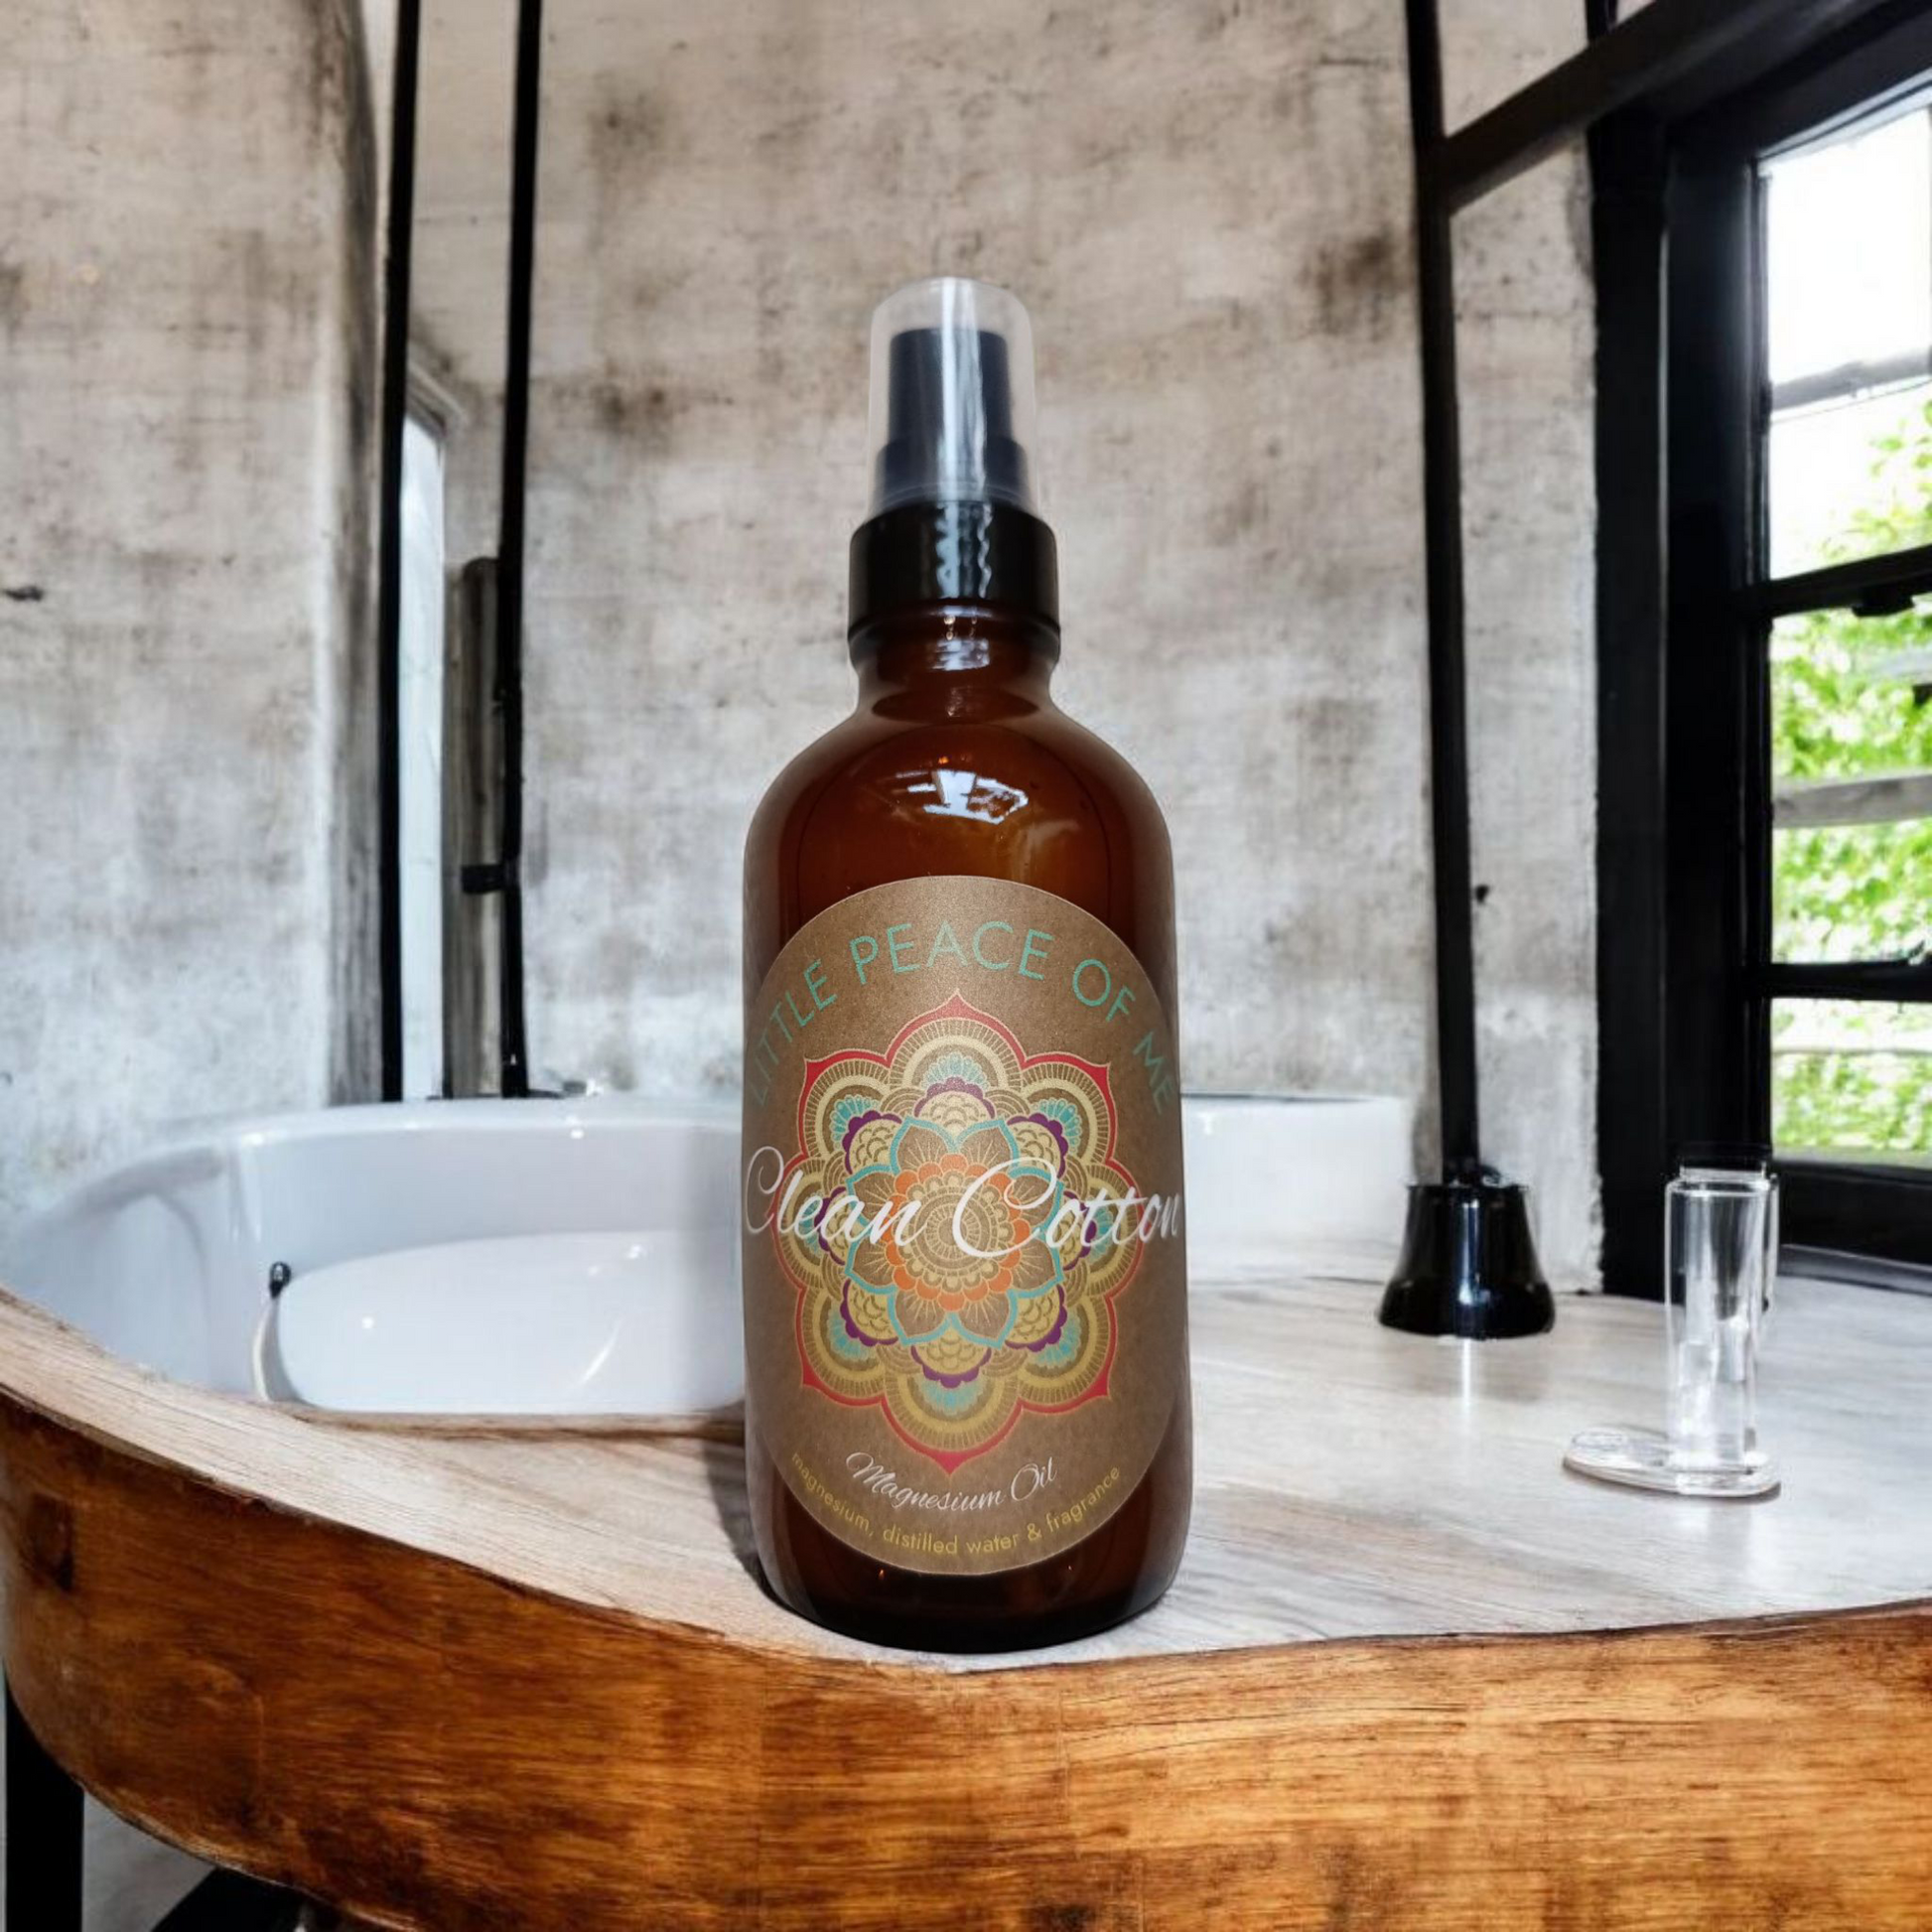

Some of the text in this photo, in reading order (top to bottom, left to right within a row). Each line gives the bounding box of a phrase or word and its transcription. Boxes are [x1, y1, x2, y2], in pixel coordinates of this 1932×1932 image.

[751, 920, 1175, 1116] LITTLE PEACE OF ME
[745, 1146, 1181, 1258] Clean Cotton
[791, 1452, 1121, 1555] magnesium, distilled water & fragrance
[846, 1451, 1058, 1511] Magnesium Oil
